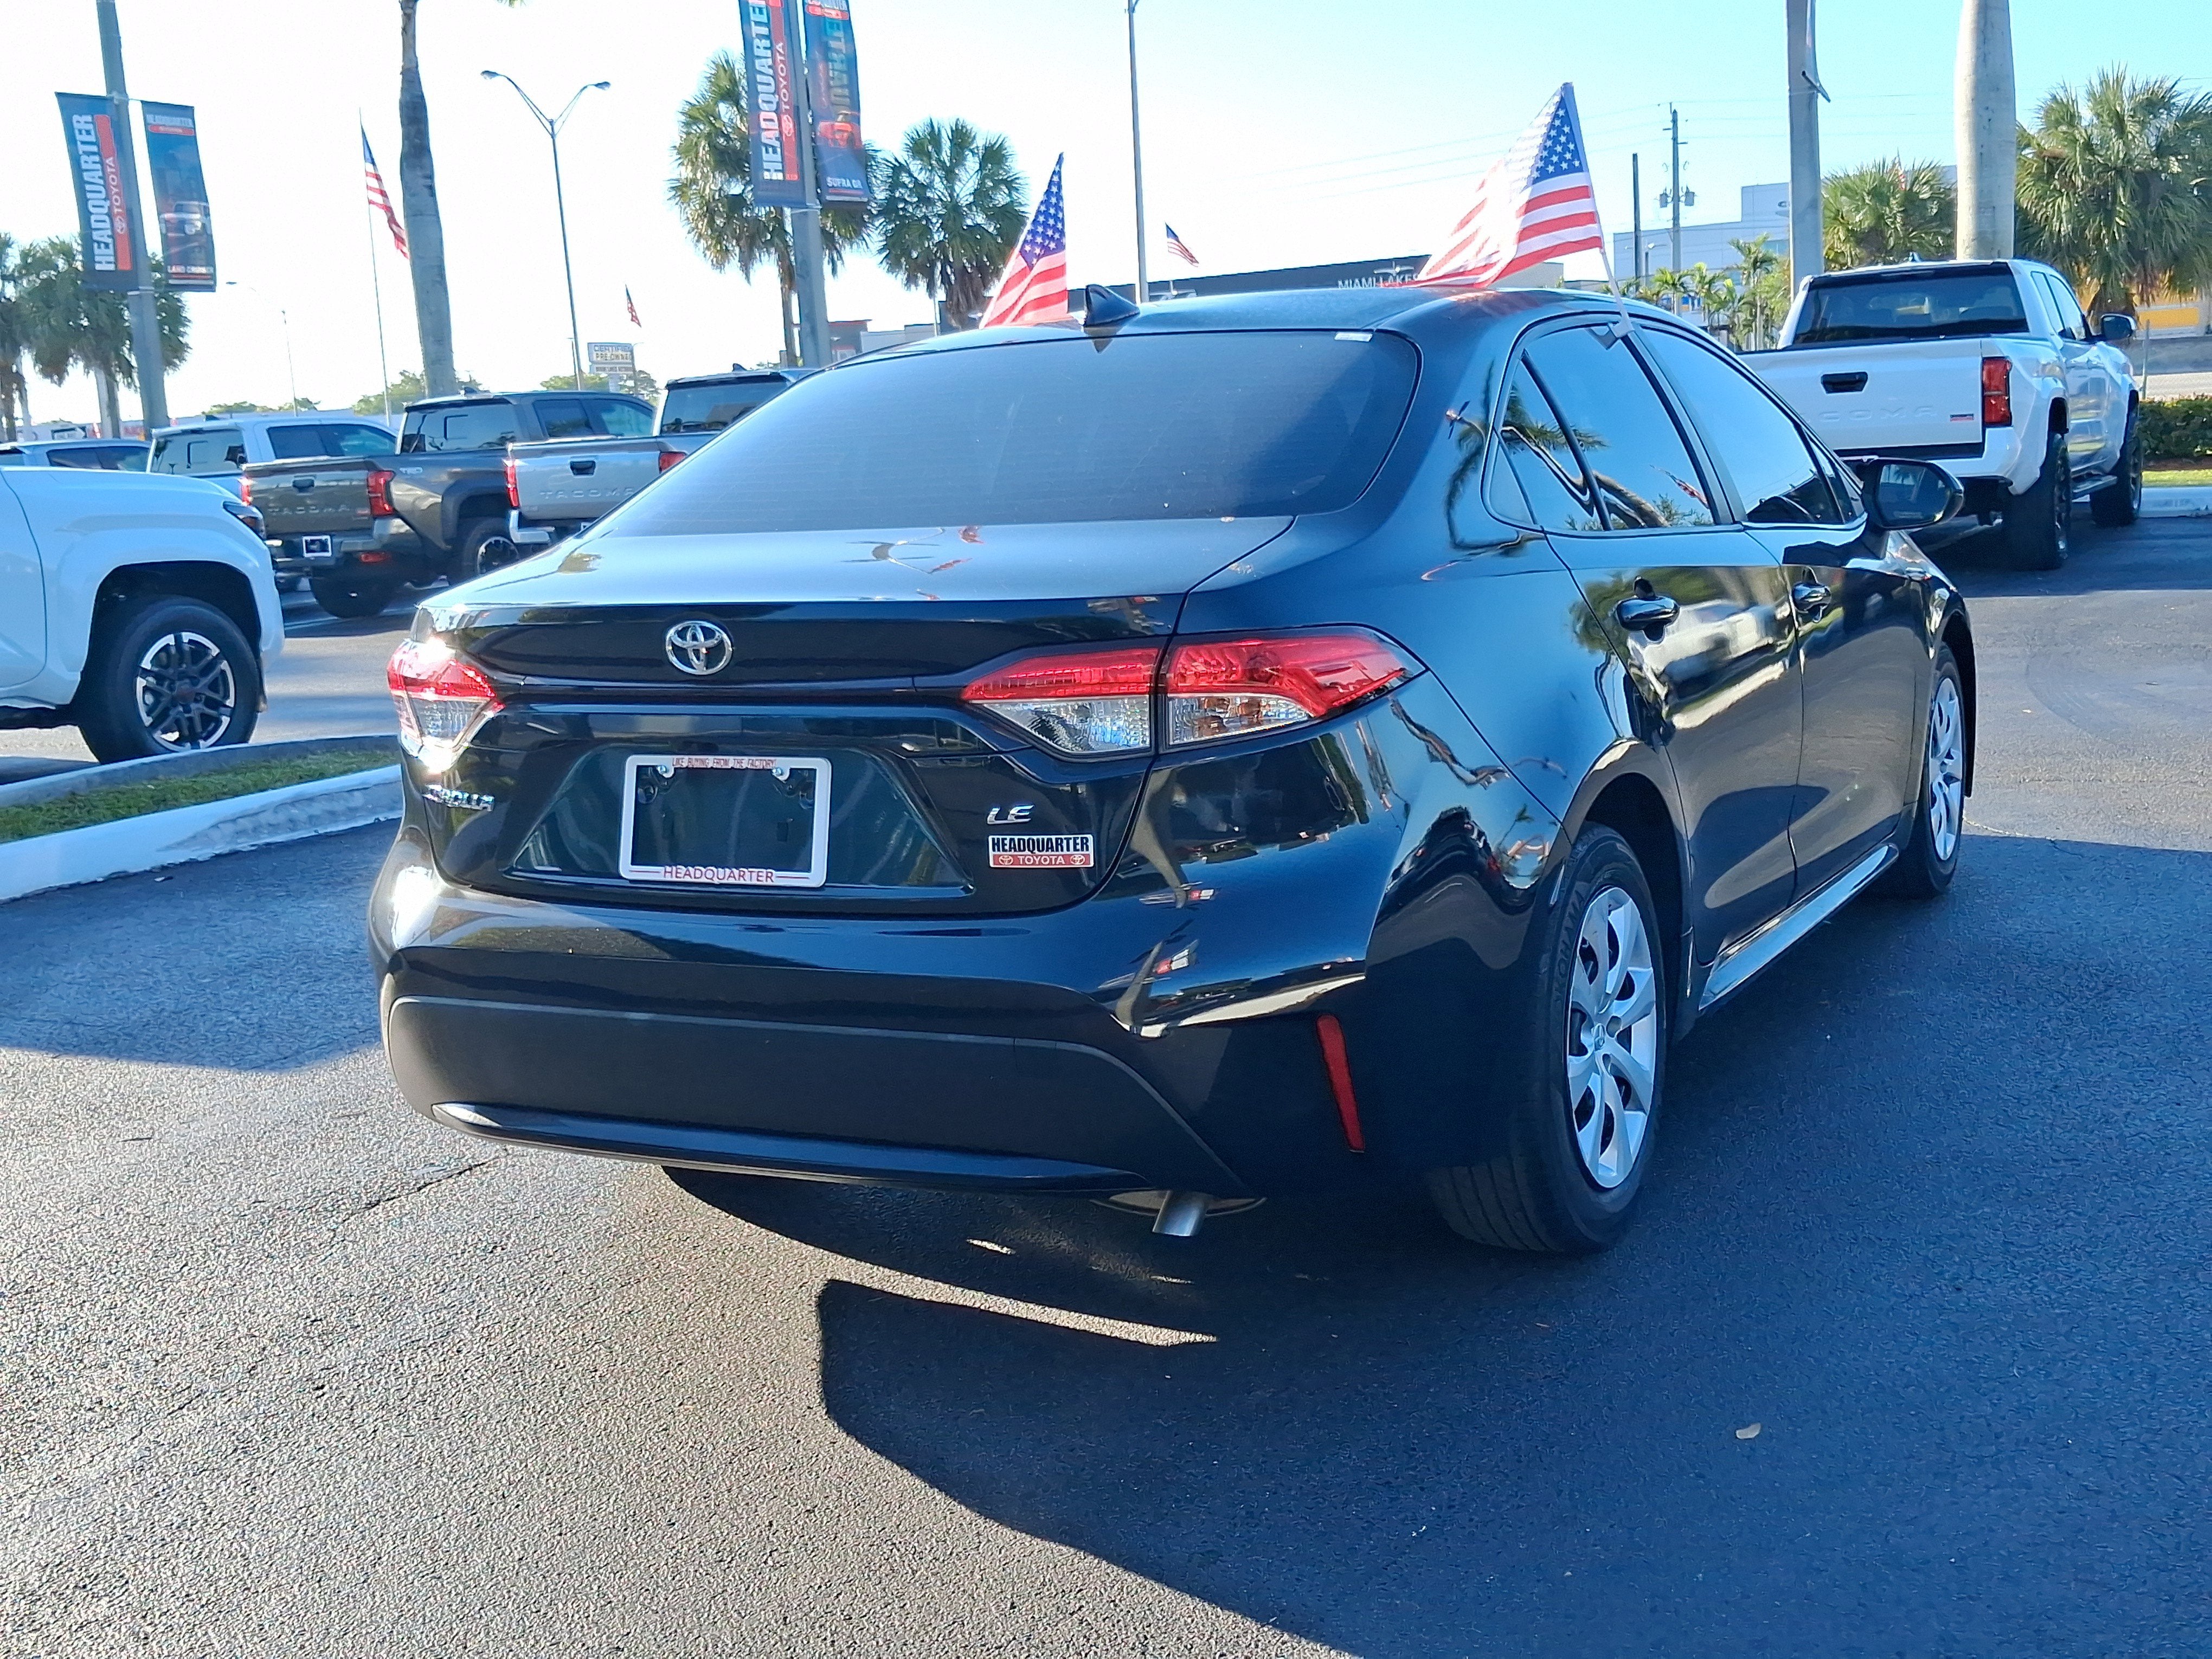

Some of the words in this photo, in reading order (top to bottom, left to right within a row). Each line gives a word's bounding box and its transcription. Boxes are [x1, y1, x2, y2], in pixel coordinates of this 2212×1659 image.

[775, 42, 790, 110] TOYOTA
[749, 0, 784, 181] HEADQUARTE
[73, 114, 115, 271] HEADQUARTER
[105, 156, 125, 214] TOYOTA
[1338, 276, 1376, 289] MIAMI
[1800, 406, 1938, 424] COMA
[987, 804, 1035, 825] LE
[992, 836, 1090, 854] HEADQUARTER
[1017, 855, 1065, 865] TOYOTA
[663, 867, 774, 883] HEADQUARTER
